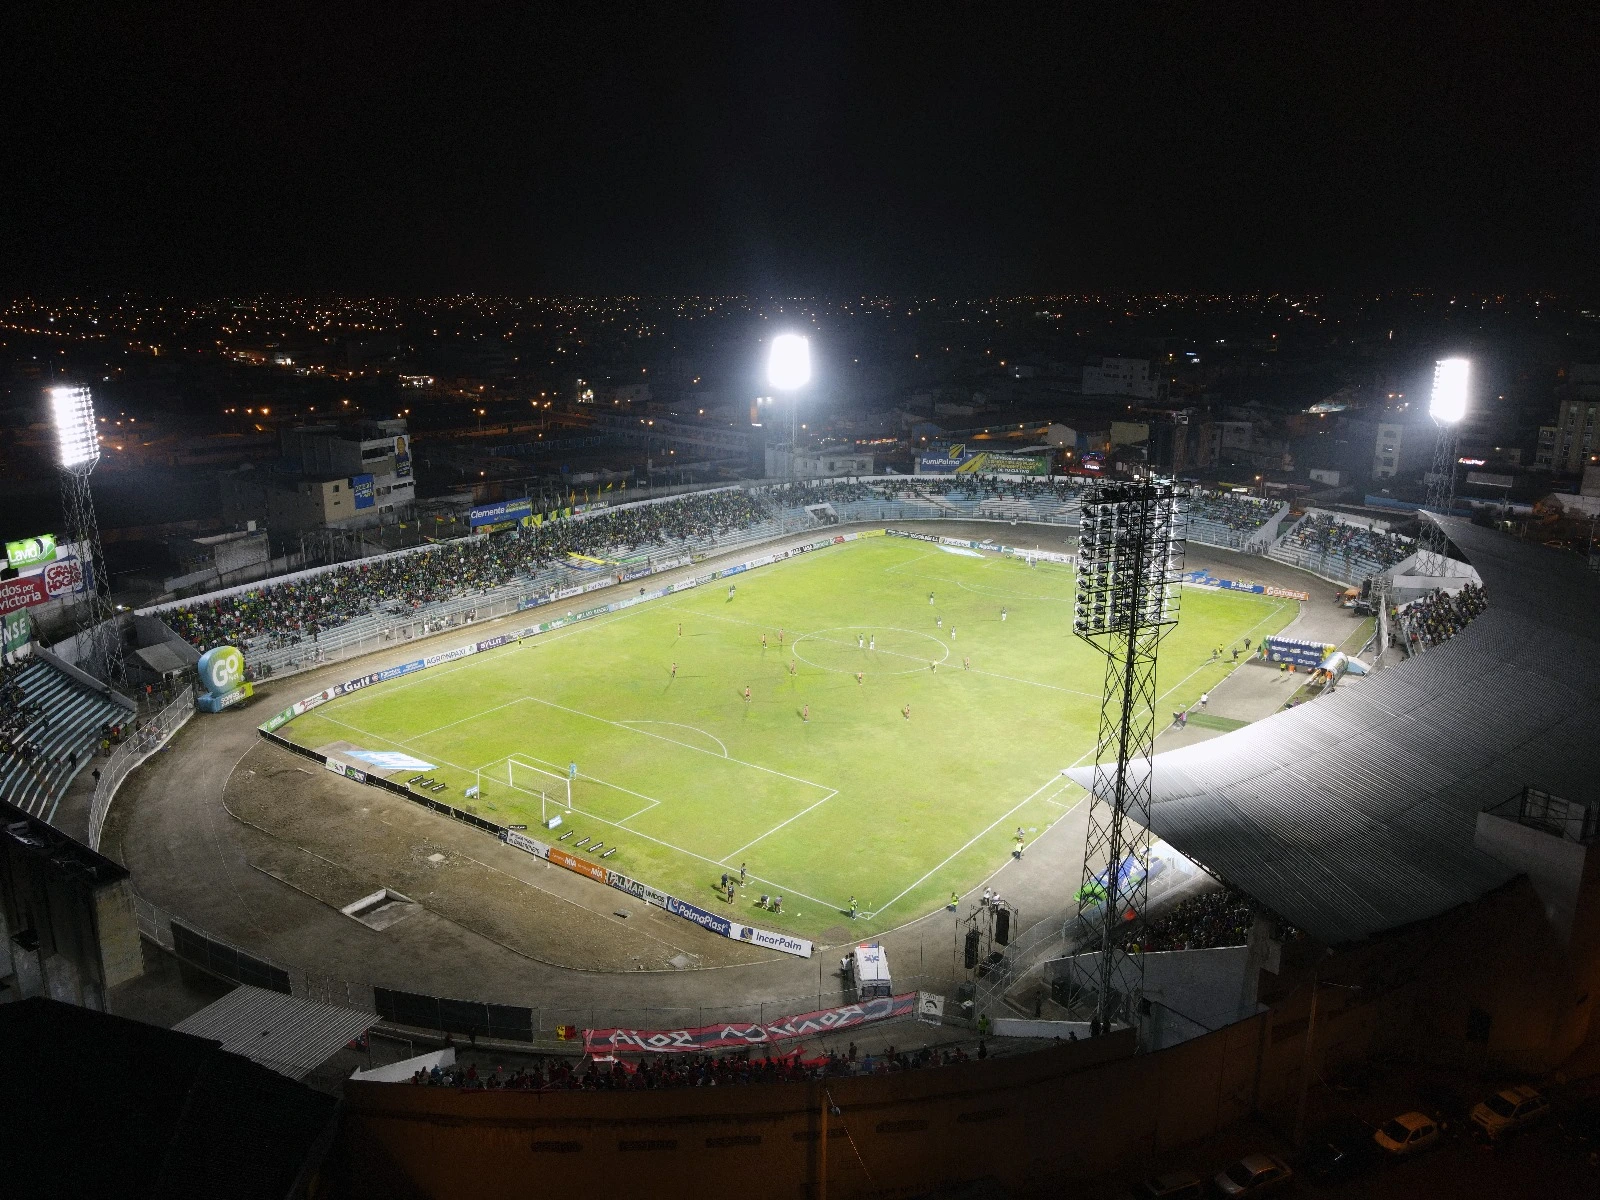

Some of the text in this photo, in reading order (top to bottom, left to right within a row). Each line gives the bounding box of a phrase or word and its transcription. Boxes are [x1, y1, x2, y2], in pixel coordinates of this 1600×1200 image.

[922, 458, 960, 466] FumiPalma
[470, 506, 505, 519] Clemente
[23, 584, 35, 593] por
[212, 654, 239, 687] GO
[344, 676, 370, 692] Gulf
[610, 873, 644, 895] PALMAR
[679, 905, 725, 932] PalmaPlast
[756, 932, 802, 951] IncorPalm
